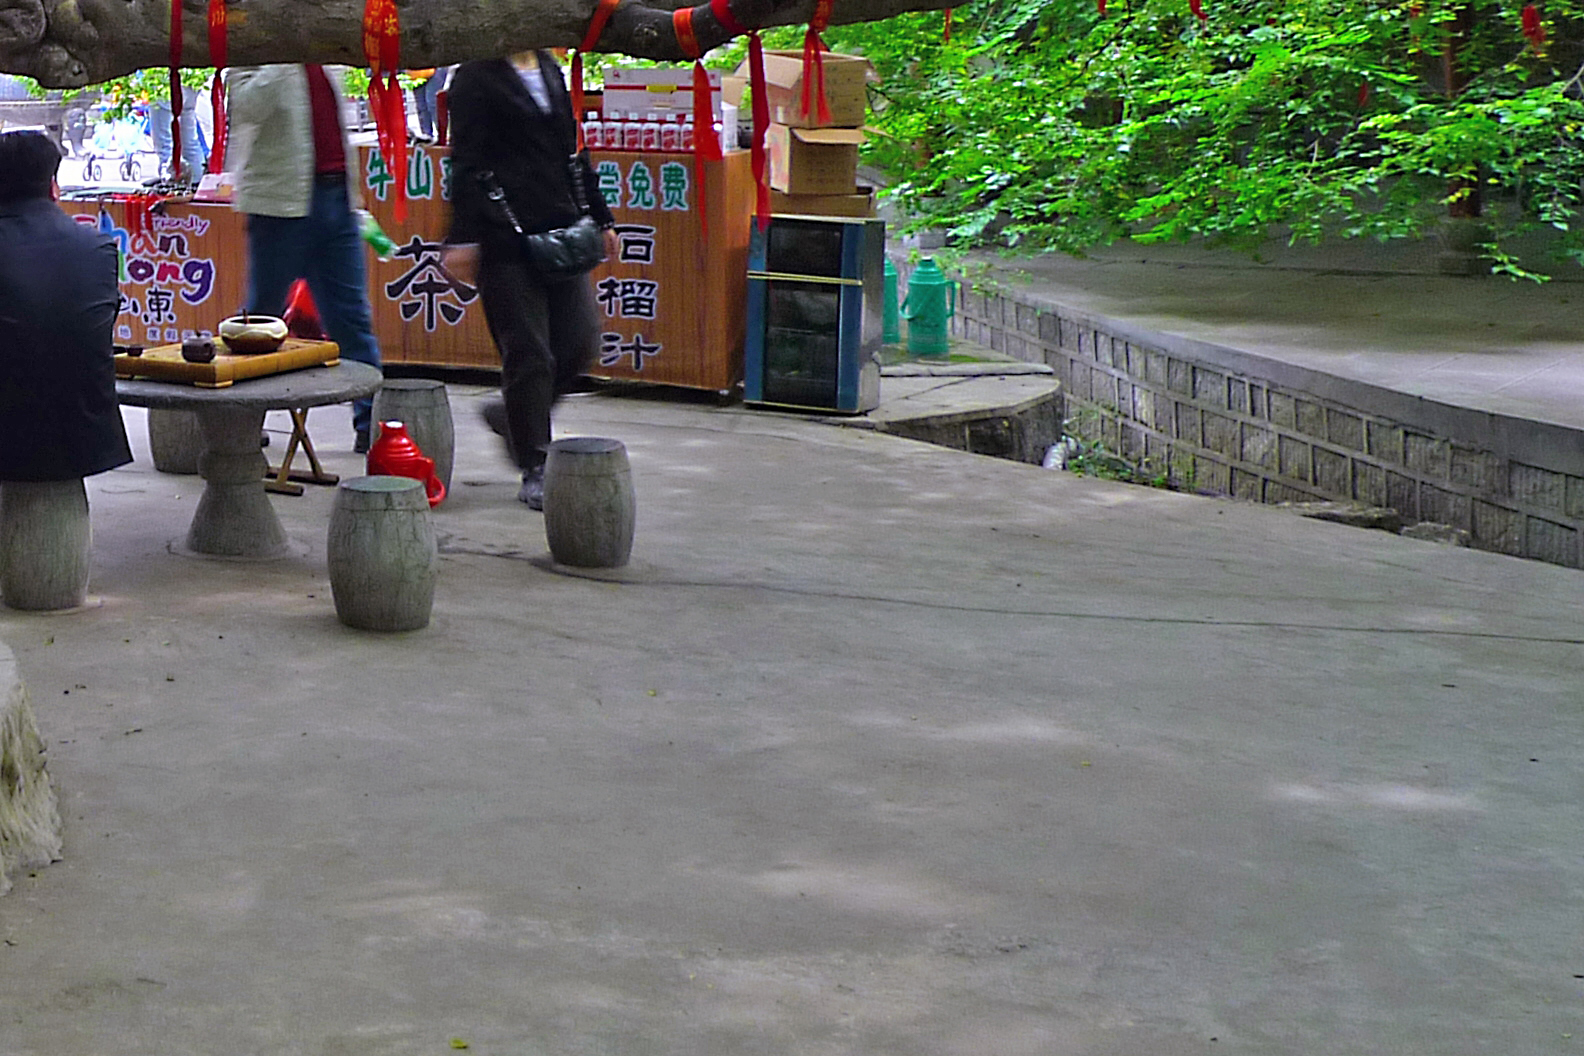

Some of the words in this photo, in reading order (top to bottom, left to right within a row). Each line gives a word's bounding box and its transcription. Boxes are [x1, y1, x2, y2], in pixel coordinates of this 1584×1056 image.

[141, 212, 210, 236] riendly
[385, 235, 480, 332] 茶
[596, 224, 662, 371] 石榴汁
